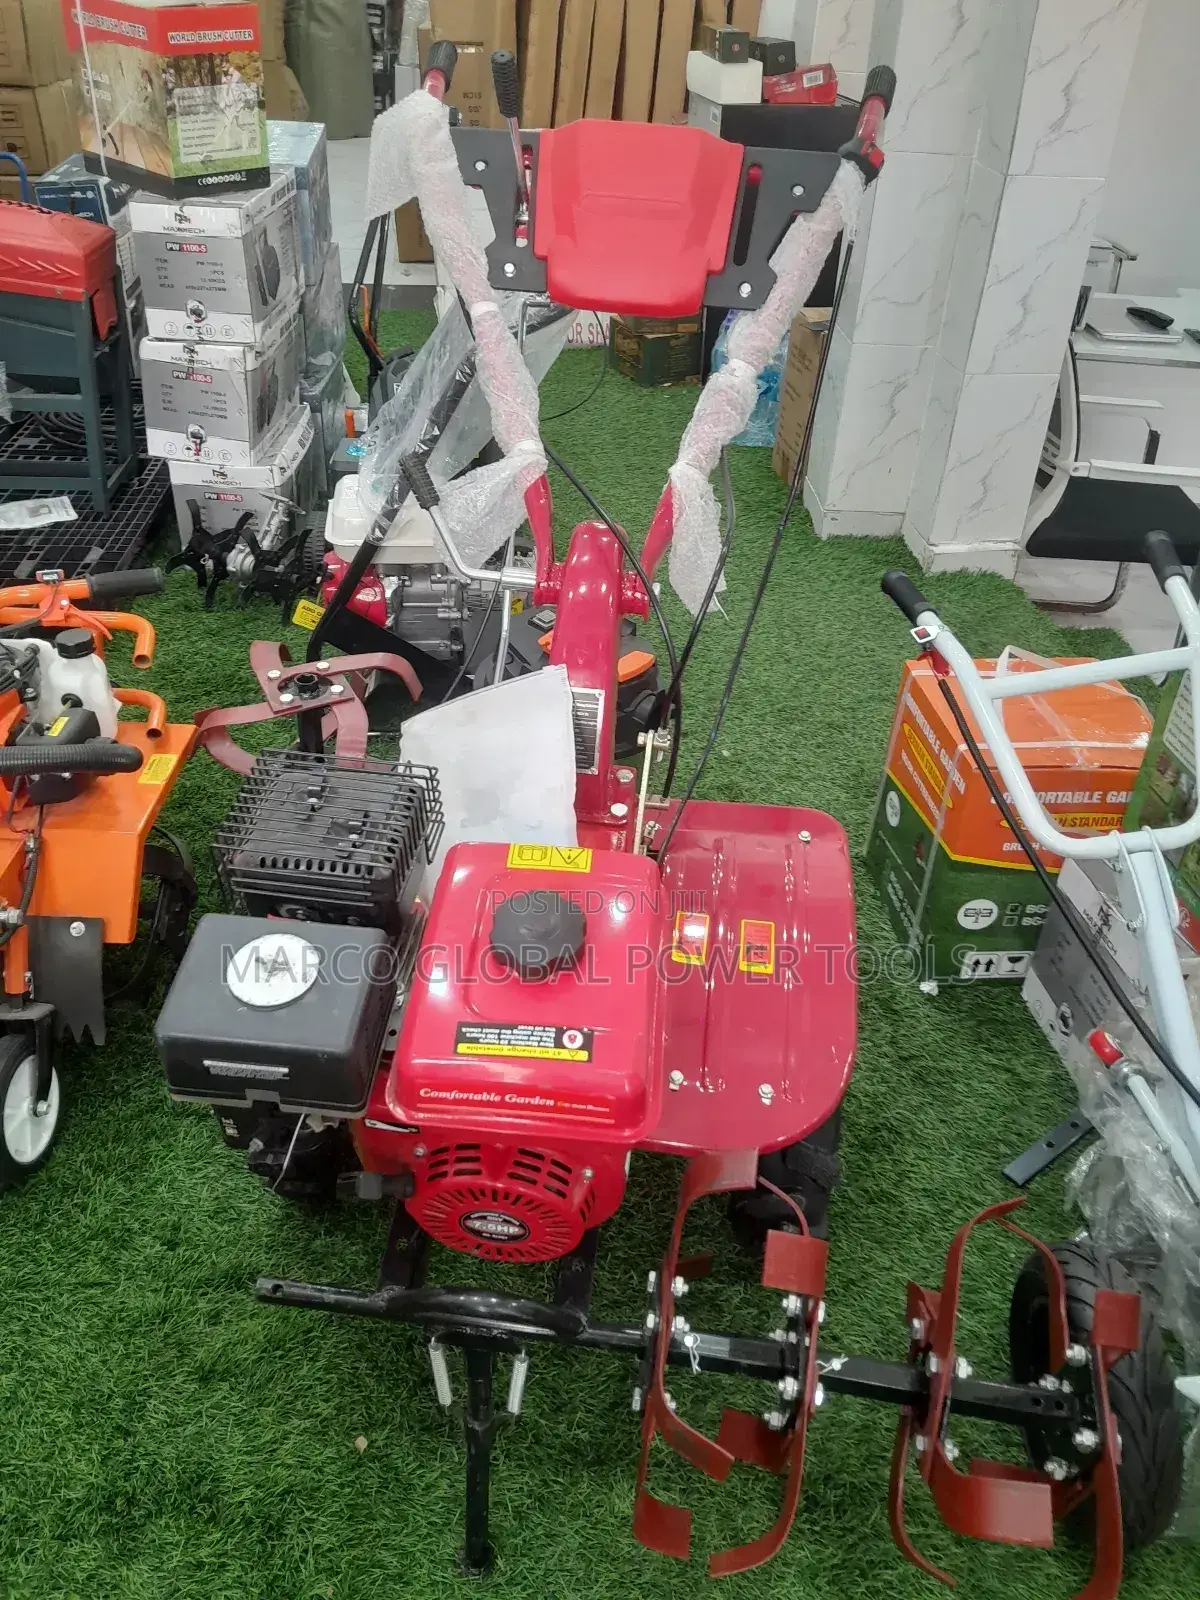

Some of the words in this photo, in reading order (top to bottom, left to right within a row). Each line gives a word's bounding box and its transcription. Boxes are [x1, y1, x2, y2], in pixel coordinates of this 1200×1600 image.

[168, 32, 196, 43] WORLD
[196, 31, 222, 42] BRUSH
[223, 29, 253, 40] CUTTER
[166, 242, 180, 251] PW
[173, 371, 186, 379] PW
[419, 1087, 501, 1102] Comfortable
[505, 1093, 554, 1107] Garden
